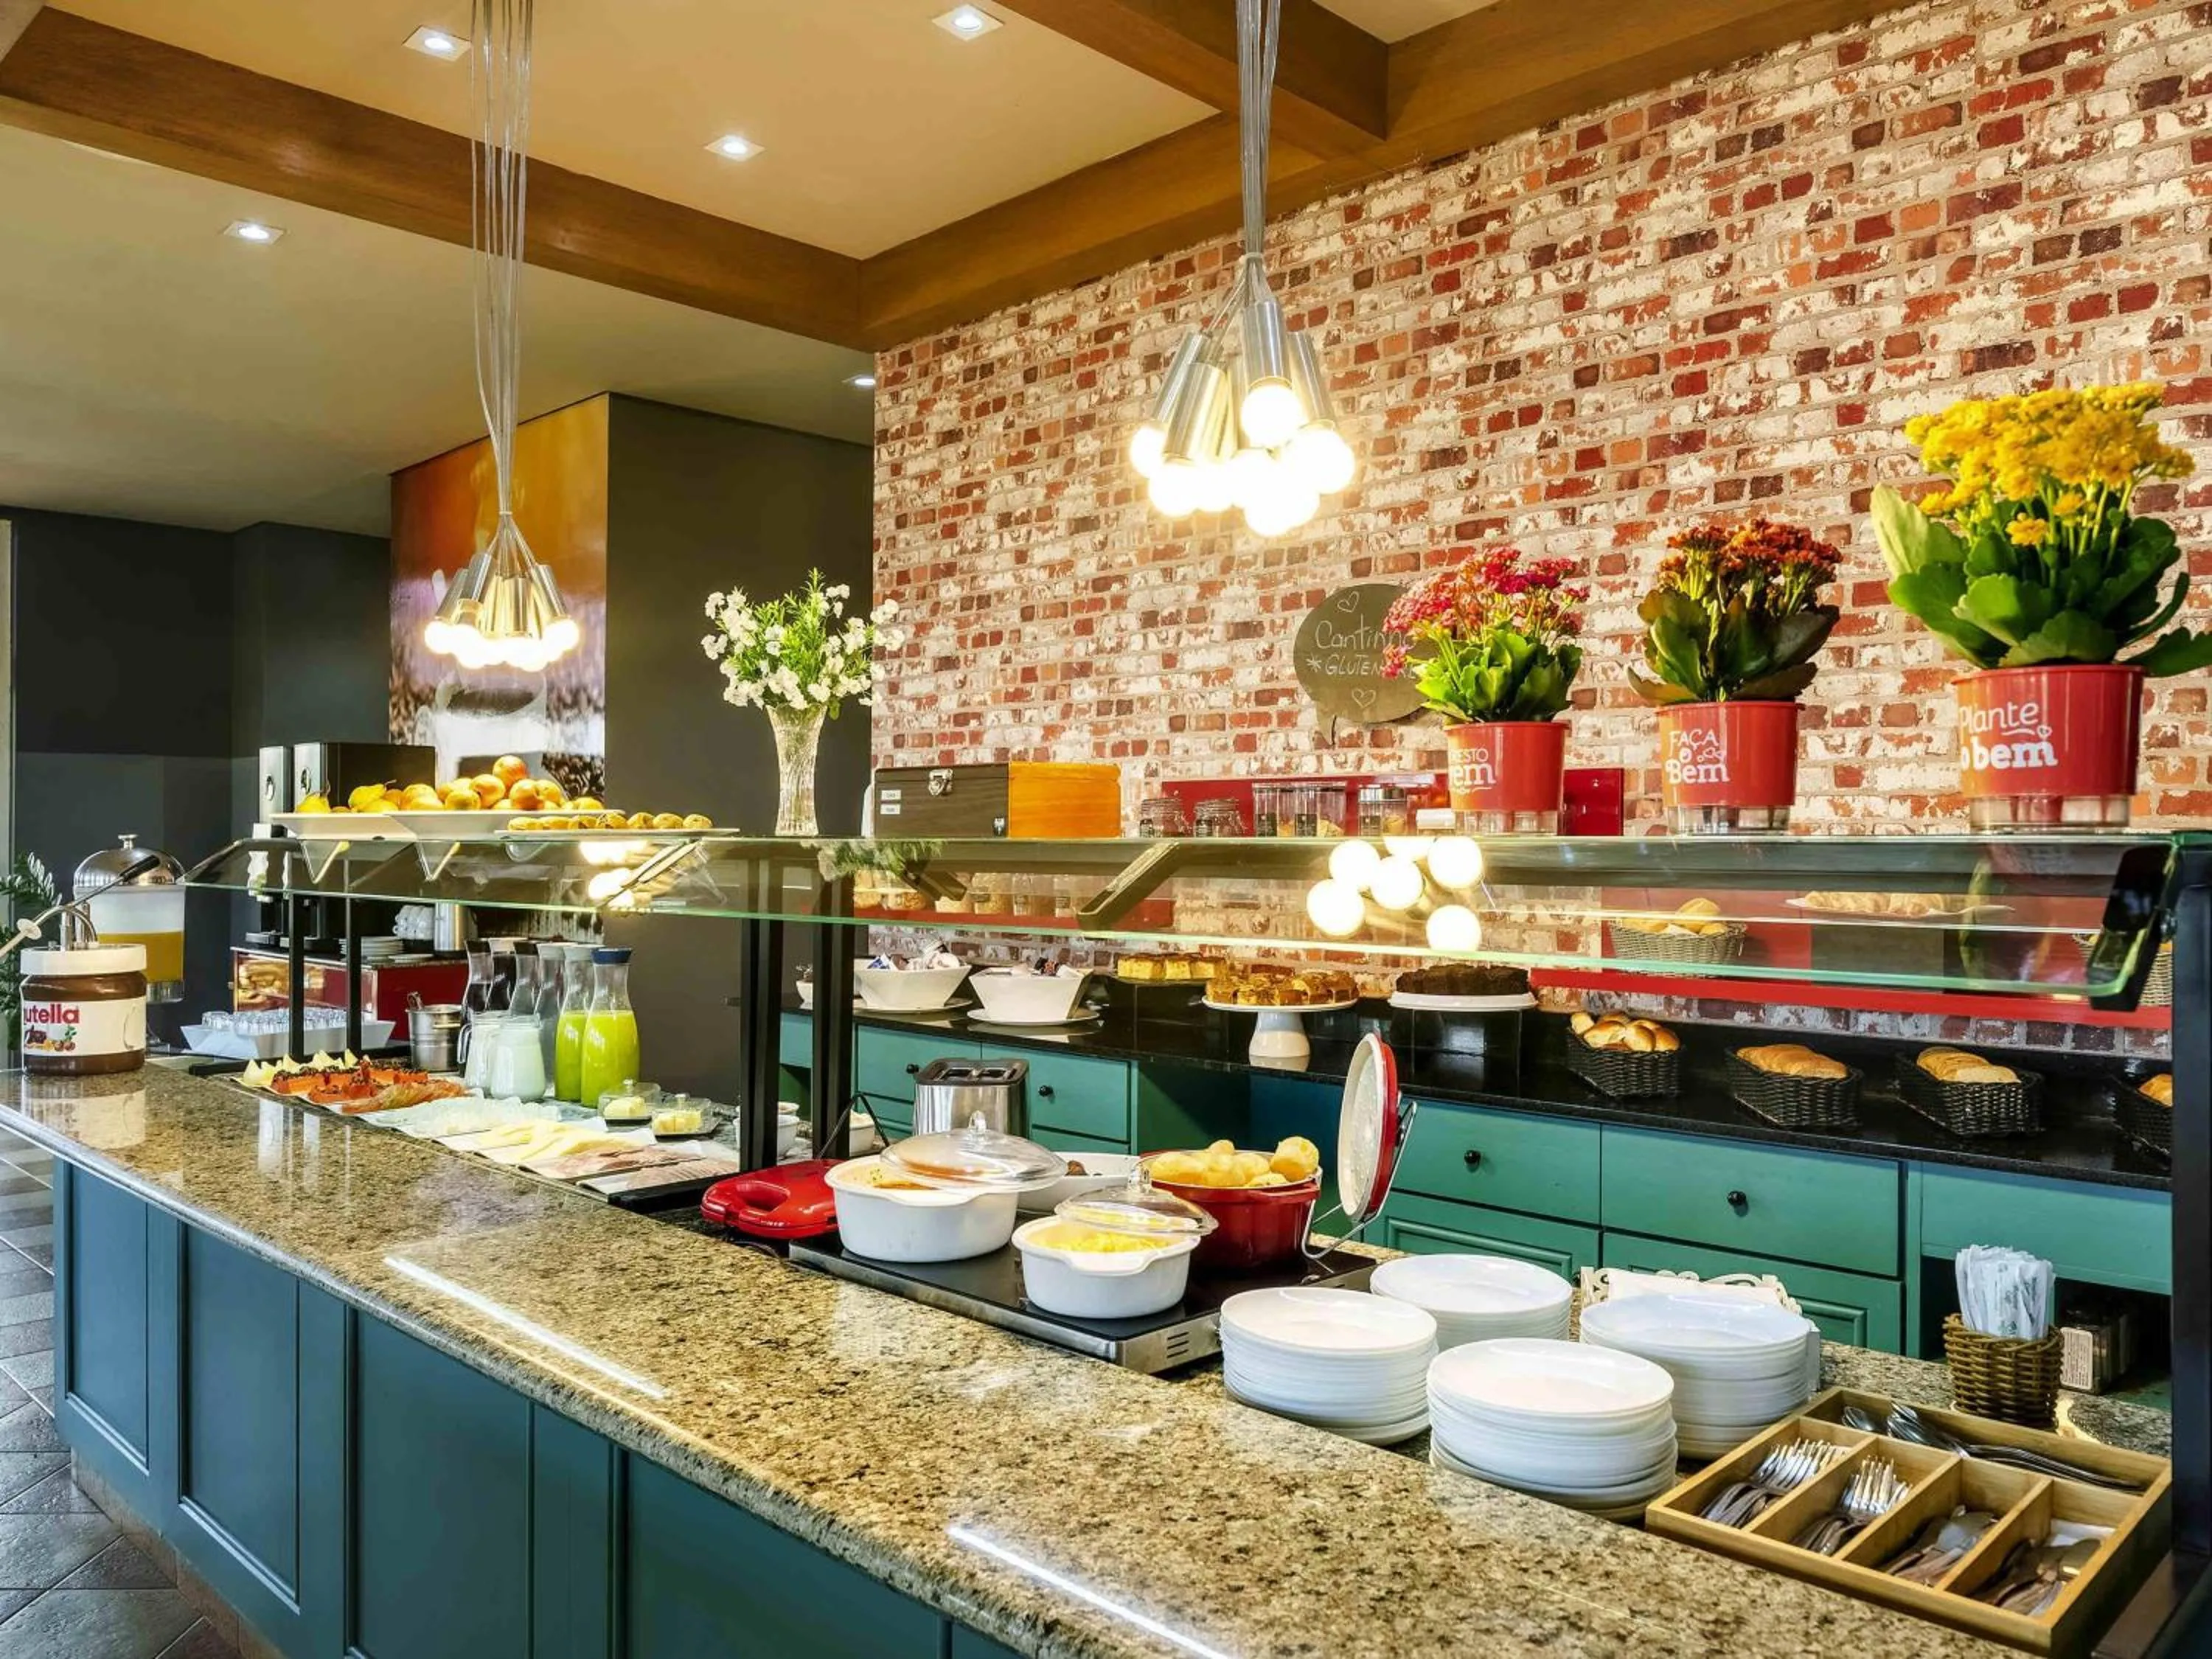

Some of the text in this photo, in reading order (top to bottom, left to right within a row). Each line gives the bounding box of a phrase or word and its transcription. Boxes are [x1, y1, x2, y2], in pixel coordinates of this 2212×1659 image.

[1970, 735, 2058, 771] bem
[1450, 762, 1497, 787] em
[1665, 758, 1731, 785] Bem
[24, 1003, 80, 1024] utella
